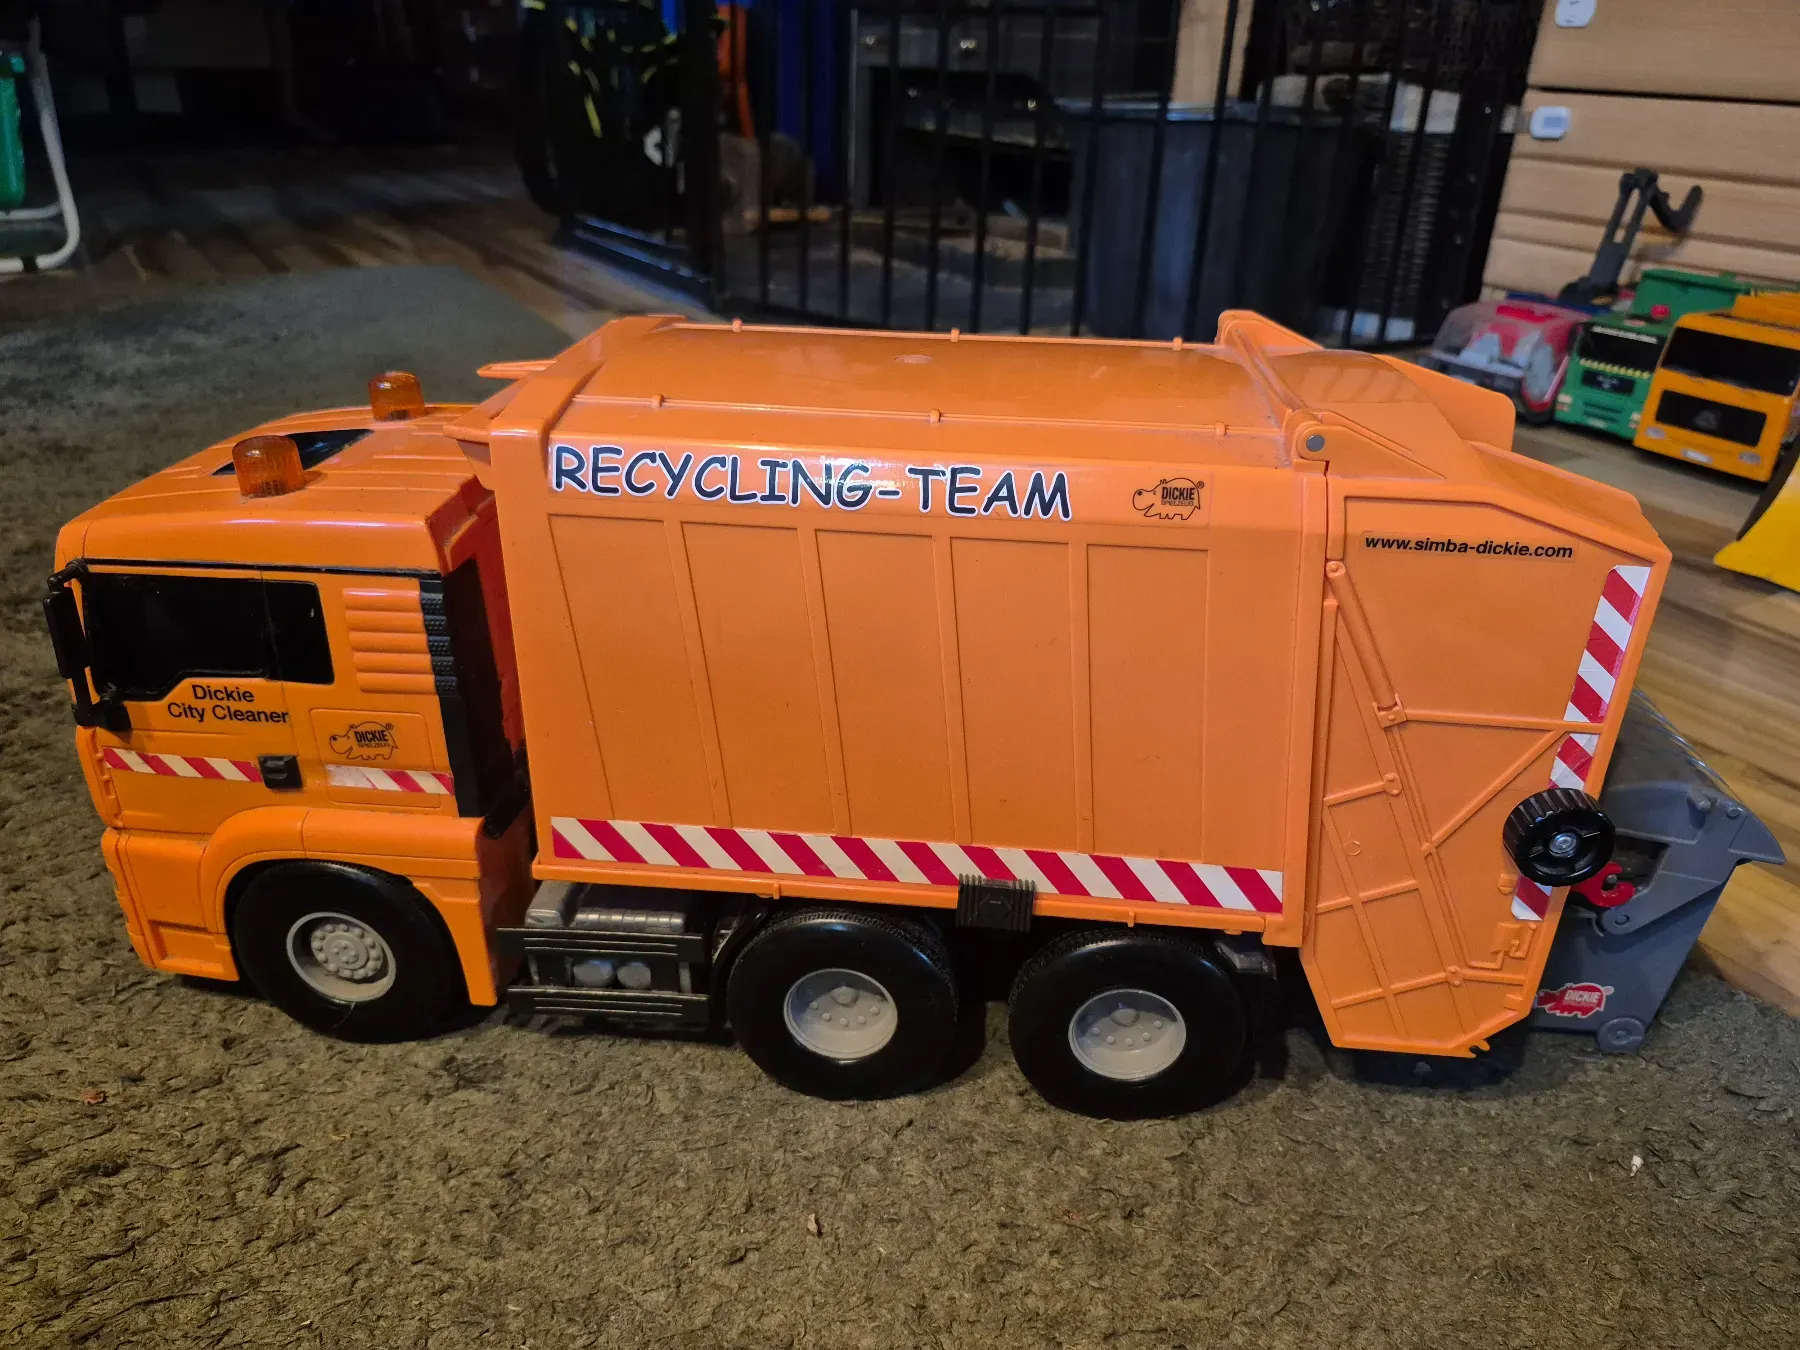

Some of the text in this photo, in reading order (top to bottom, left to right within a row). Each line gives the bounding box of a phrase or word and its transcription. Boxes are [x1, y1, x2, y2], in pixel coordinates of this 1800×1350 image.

[550, 446, 1073, 521] RECYCLING-TEAM
[1162, 487, 1196, 500] DICKIE
[1365, 537, 1573, 558] www.simba-dickie.com
[192, 684, 254, 702] Dickie
[168, 702, 289, 723] City Cleaner
[354, 729, 389, 742] DICKIE
[1564, 990, 1602, 1003] DICKIE
